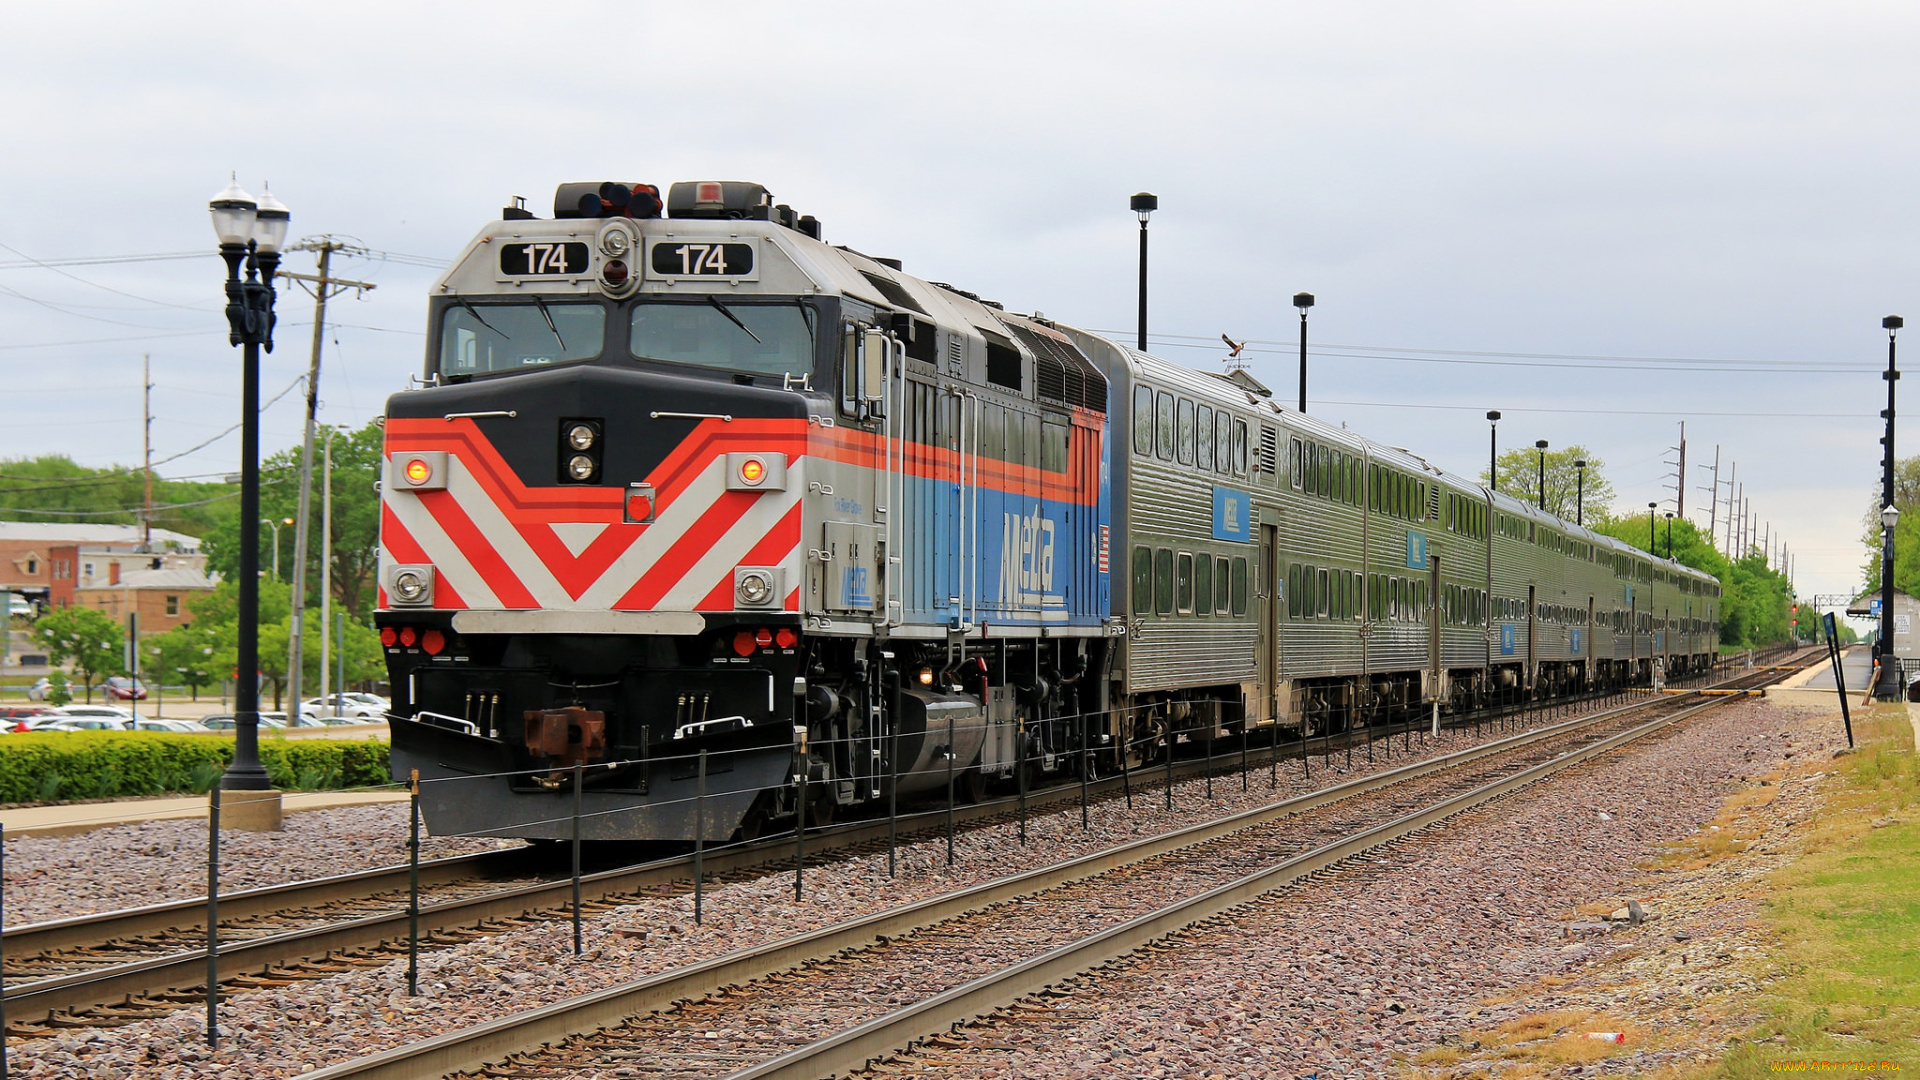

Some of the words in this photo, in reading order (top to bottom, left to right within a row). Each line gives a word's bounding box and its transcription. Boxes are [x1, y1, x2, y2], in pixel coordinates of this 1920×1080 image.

[522, 244, 568, 274] 174
[676, 244, 728, 275] 174
[997, 504, 1056, 620] Metra
